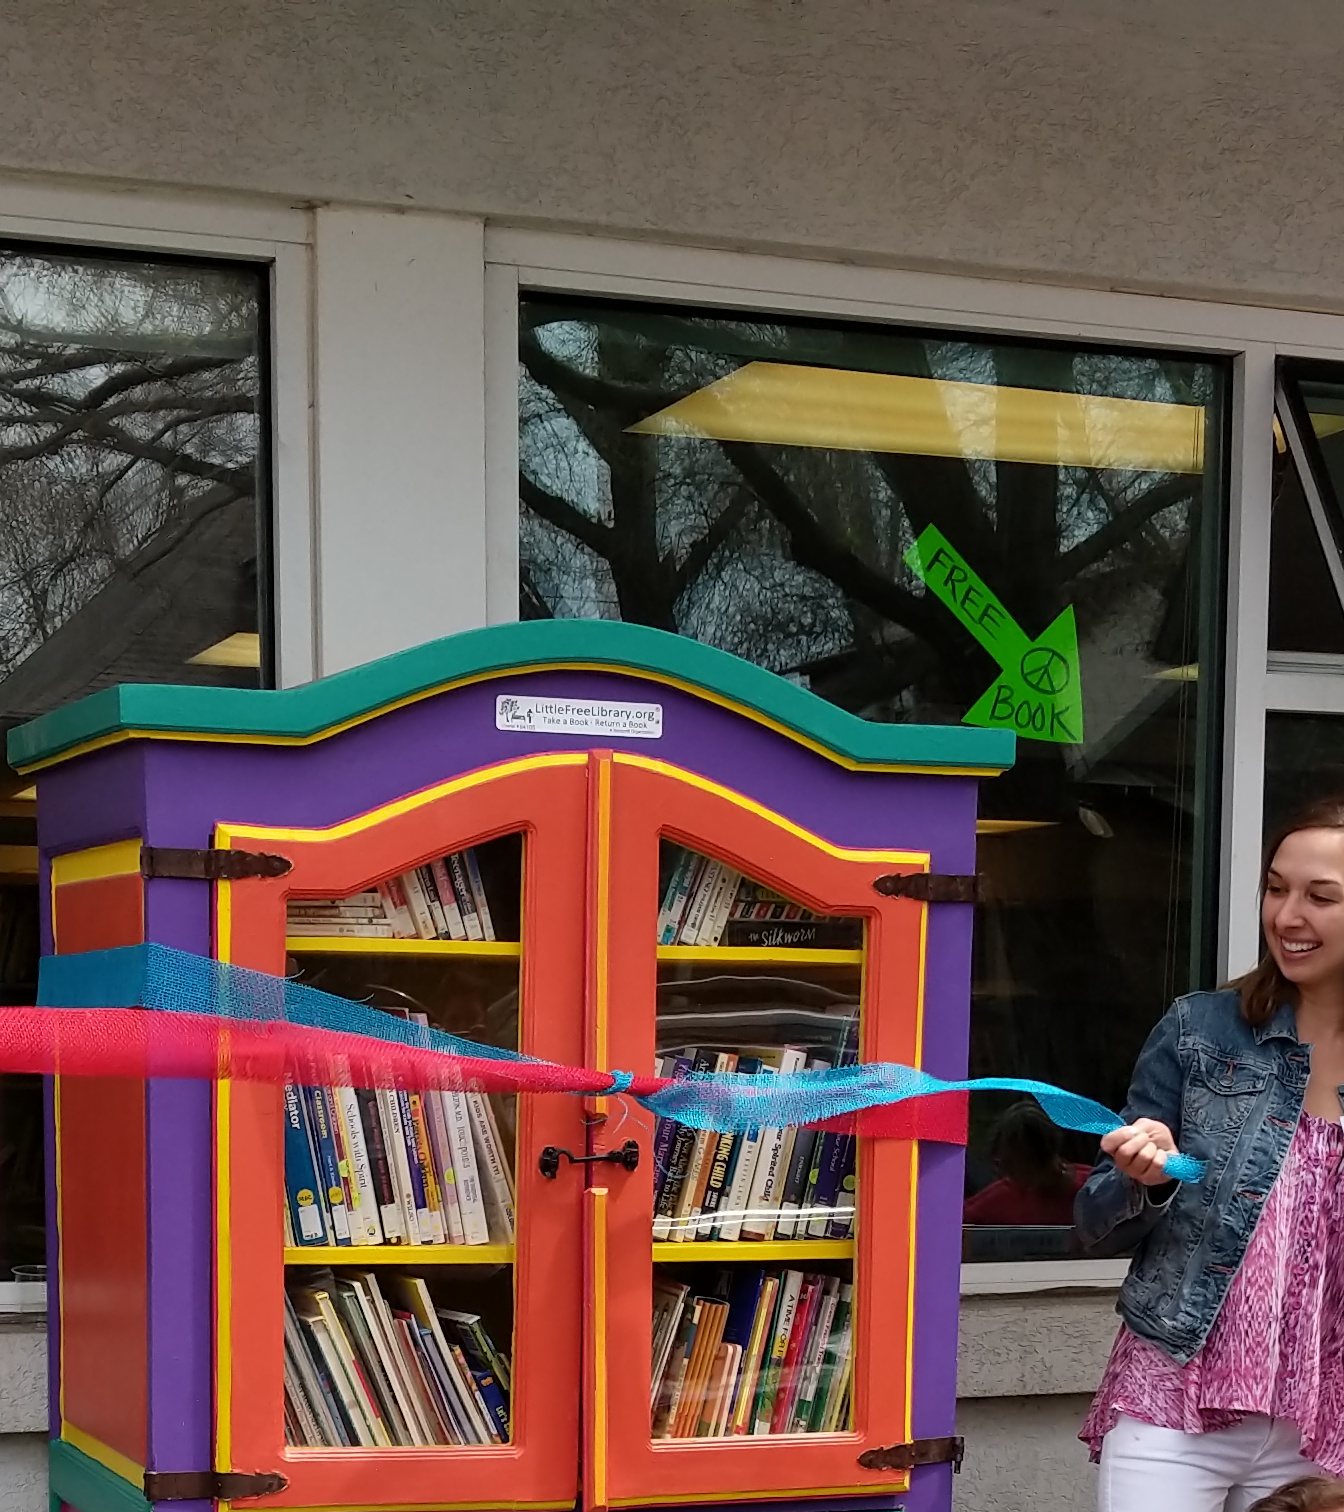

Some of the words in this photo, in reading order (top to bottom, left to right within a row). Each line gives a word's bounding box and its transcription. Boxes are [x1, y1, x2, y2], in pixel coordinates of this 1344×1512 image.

[926, 547, 1006, 641] FREE
[535, 703, 655, 722] LittleFreeLibrary.org
[543, 716, 561, 725] Take
[570, 718, 589, 726] Book
[629, 721, 647, 729] Book
[989, 684, 1077, 741] BOOK
